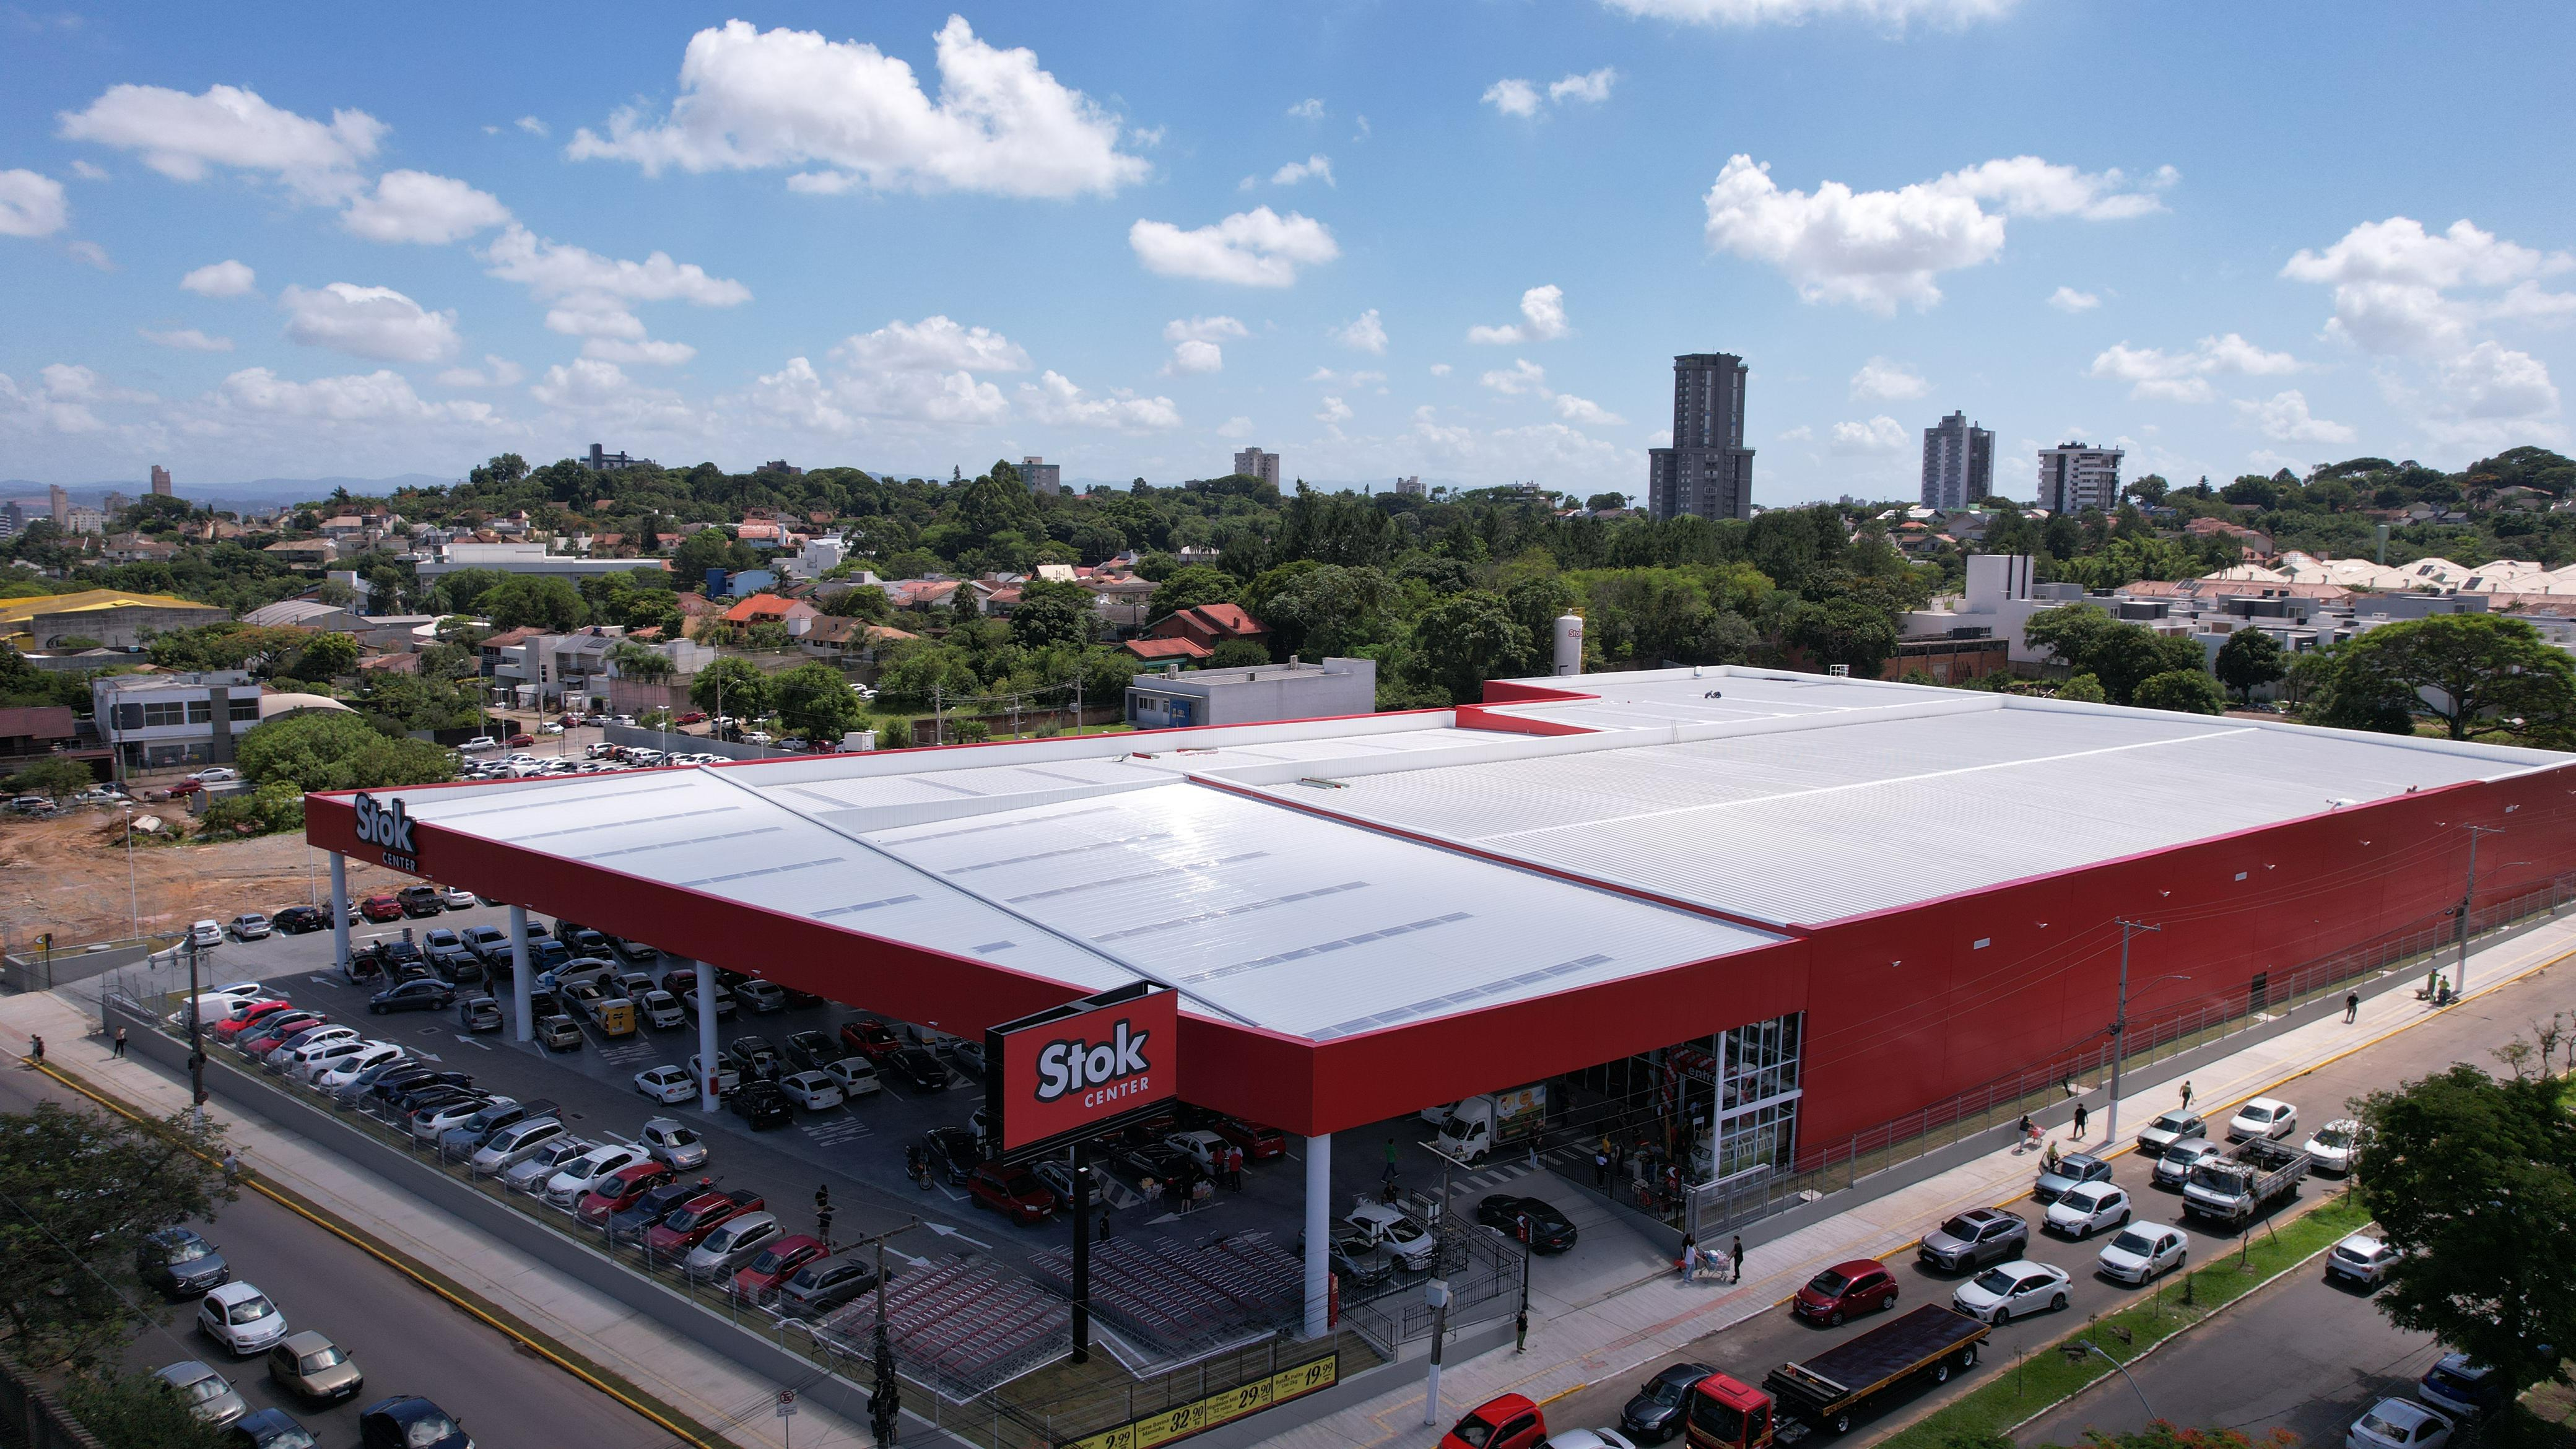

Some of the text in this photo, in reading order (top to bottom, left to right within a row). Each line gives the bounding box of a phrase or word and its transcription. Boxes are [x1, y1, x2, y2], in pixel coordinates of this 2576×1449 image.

[356, 794, 414, 853] Stok
[382, 851, 416, 872] CENTER
[1038, 1022, 1147, 1099] Stok
[1084, 1076, 1149, 1108] CENTER
[1216, 1393, 1229, 1402] Papel
[1138, 1424, 1152, 1432] Carne
[1152, 1417, 1169, 1427] Bovina
[1142, 1425, 1165, 1437] Maminha
